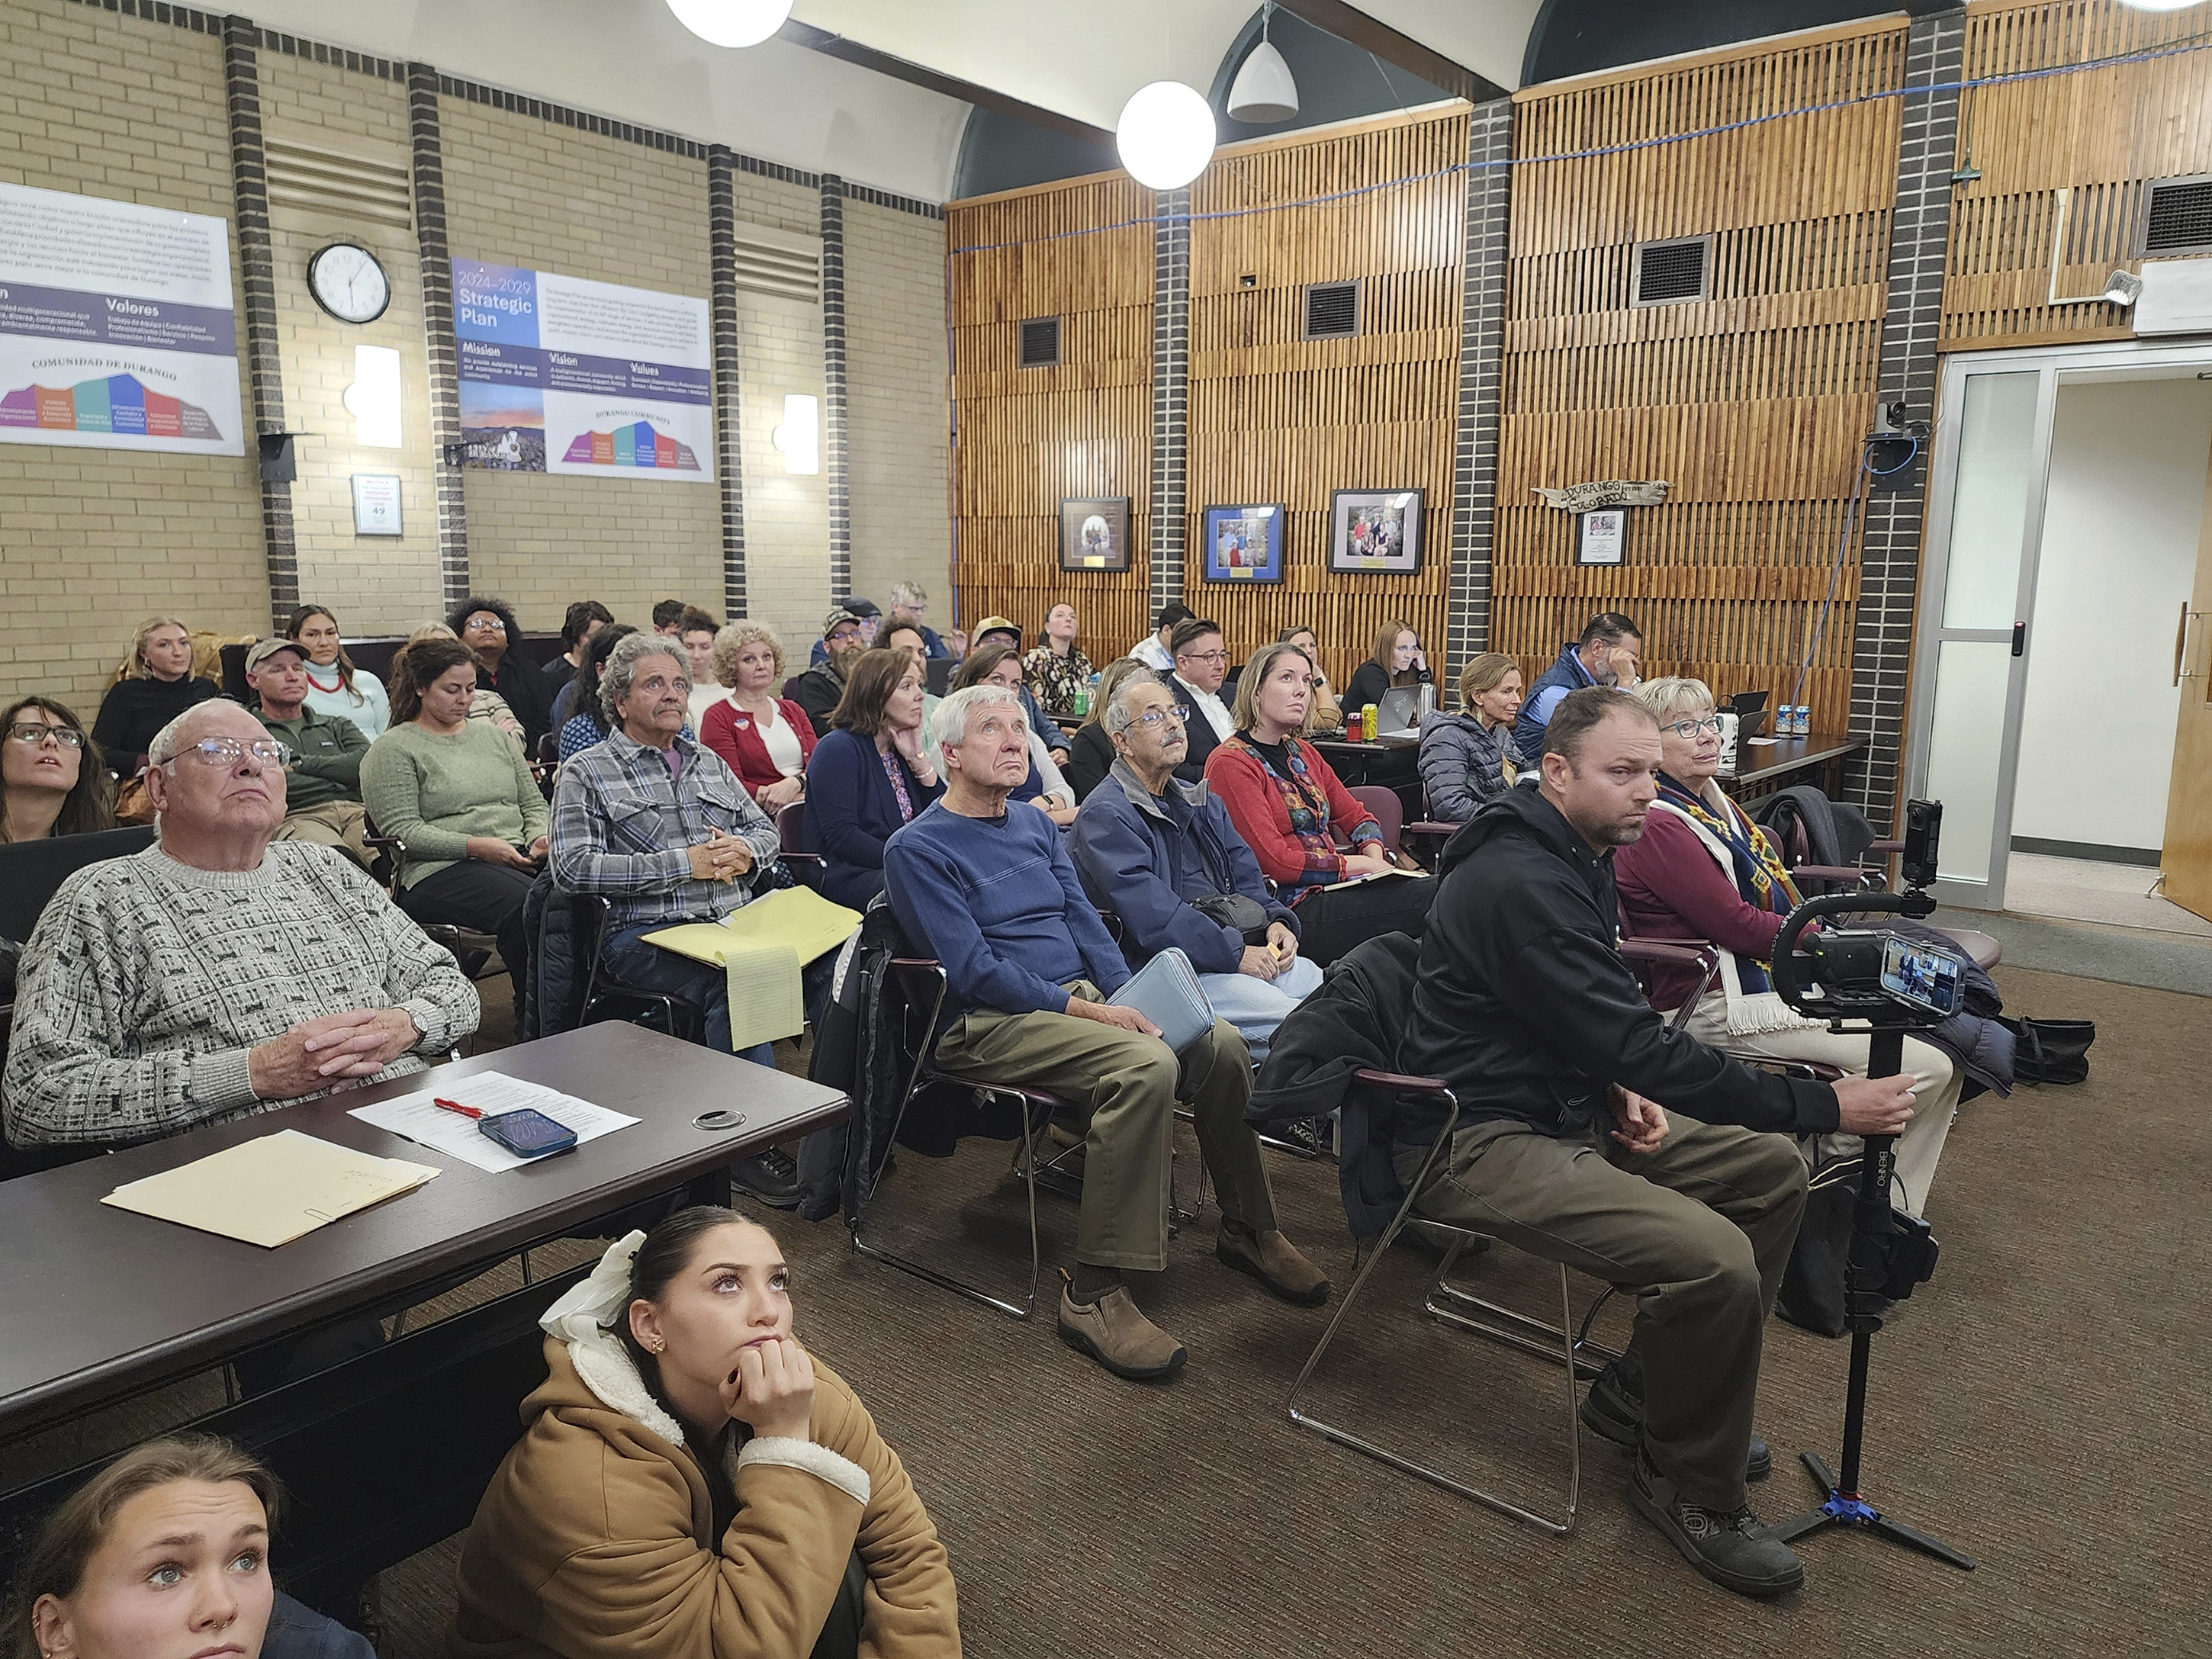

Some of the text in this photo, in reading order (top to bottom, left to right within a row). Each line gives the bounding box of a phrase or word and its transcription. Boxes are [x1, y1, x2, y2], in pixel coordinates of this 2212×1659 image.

[105, 297, 159, 317] Valores
[459, 288, 532, 316] Strategic
[460, 307, 497, 327] Plan
[461, 341, 500, 357] Mission
[548, 352, 578, 366] Vision
[32, 358, 178, 381] COMUNIDAD DE DURANGO
[629, 362, 659, 376] Values
[1565, 480, 1620, 498] DURANGO
[1568, 491, 1628, 510] COLORADO
[1876, 1150, 1889, 1187] BENRO
